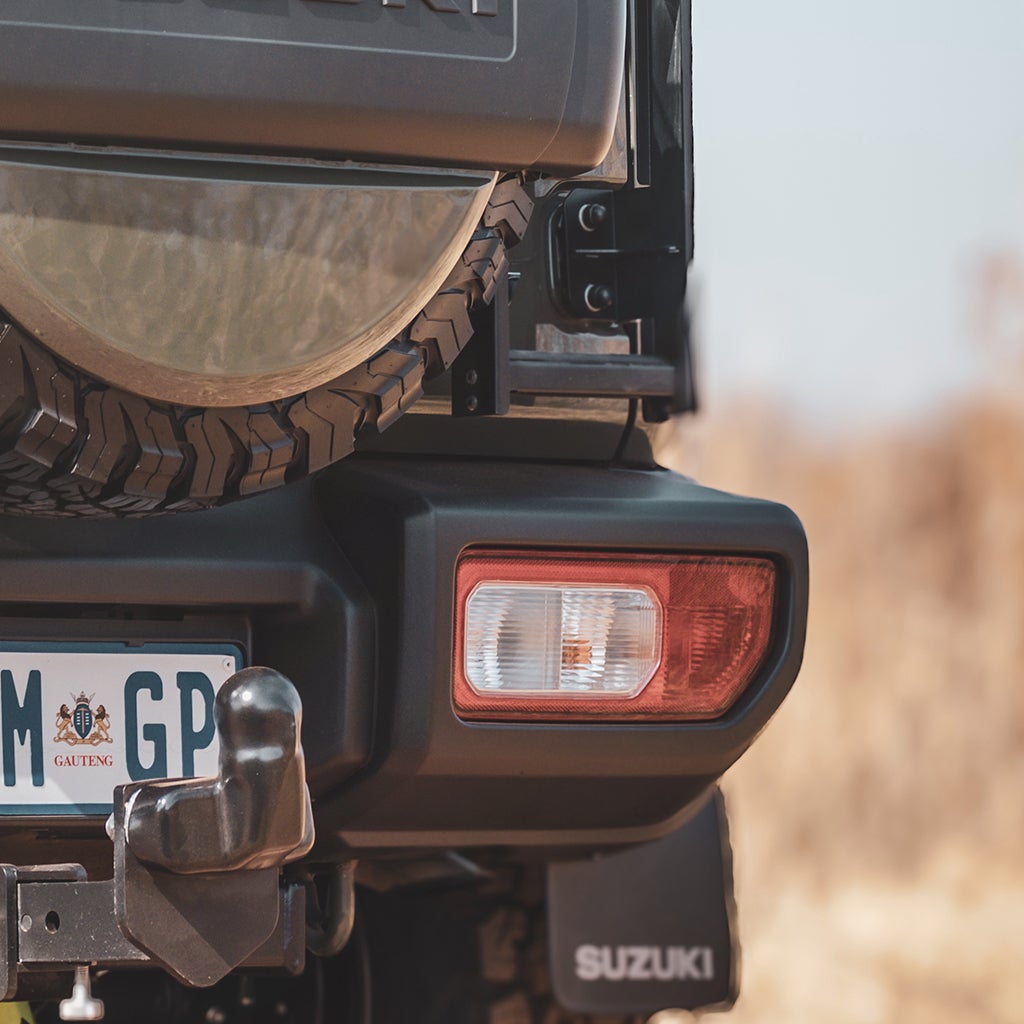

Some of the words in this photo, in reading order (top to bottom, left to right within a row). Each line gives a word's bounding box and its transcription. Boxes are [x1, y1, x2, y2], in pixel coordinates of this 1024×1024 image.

[124, 671, 216, 781] GP
[54, 754, 113, 767] GAUTENG
[575, 944, 714, 981] SUZUKI
